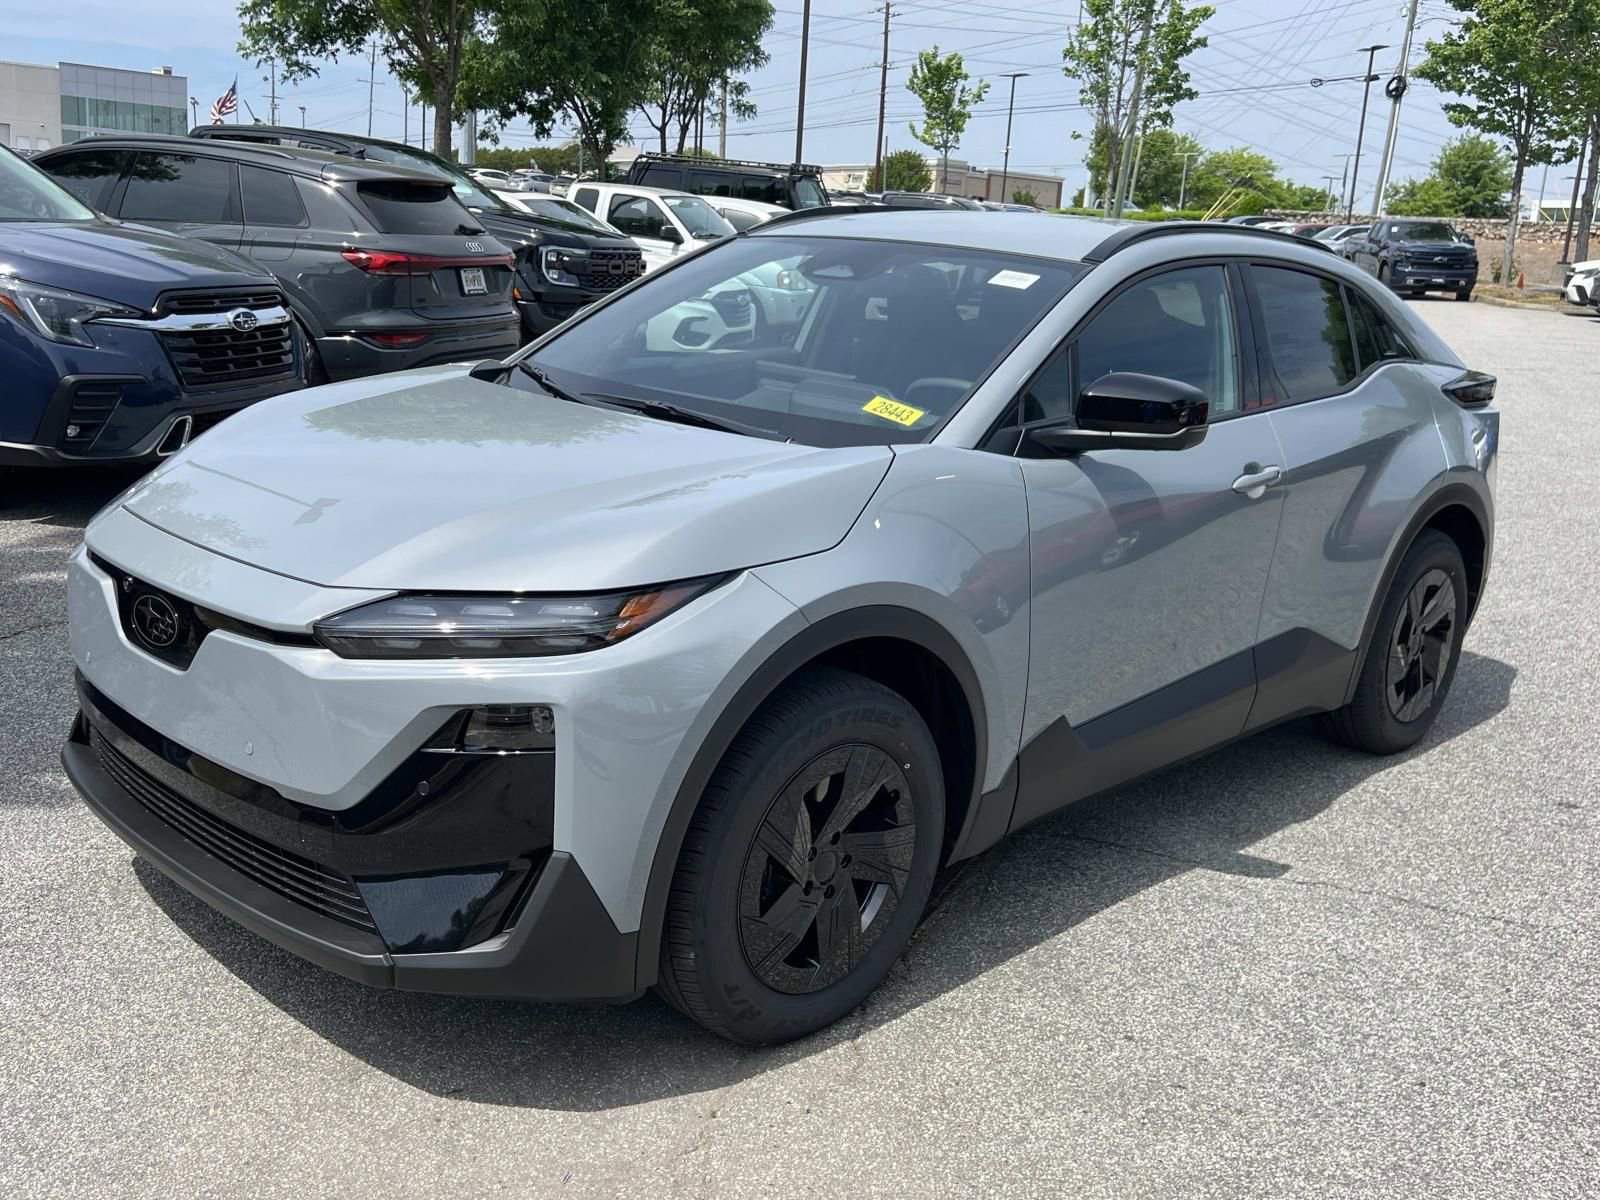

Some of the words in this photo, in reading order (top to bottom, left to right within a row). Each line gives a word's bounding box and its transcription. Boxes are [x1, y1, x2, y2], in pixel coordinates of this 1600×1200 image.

[587, 259, 648, 275] FORD
[872, 401, 914, 422] 28443
[836, 706, 903, 729] TIRES
